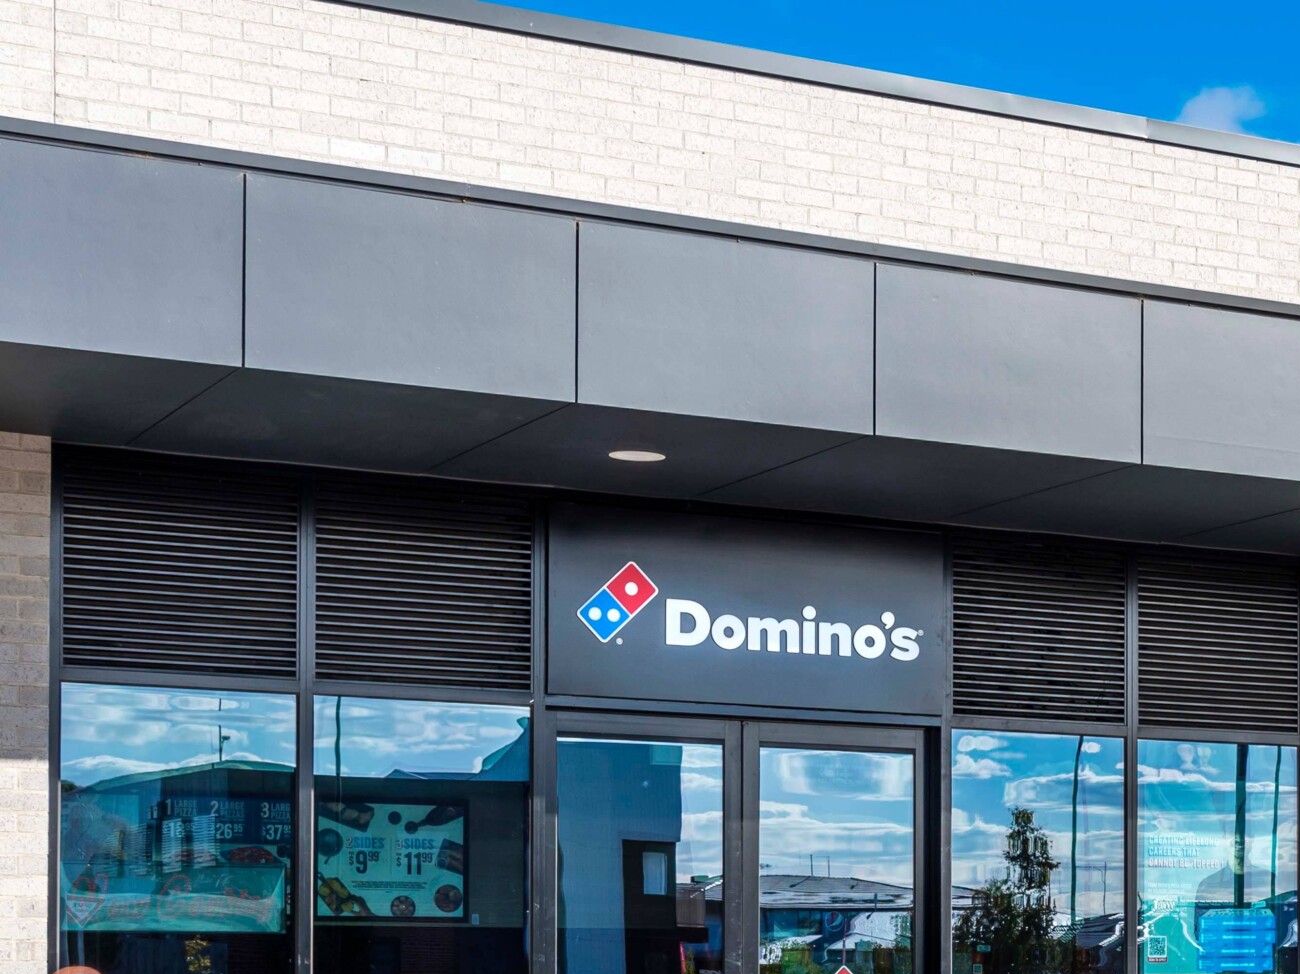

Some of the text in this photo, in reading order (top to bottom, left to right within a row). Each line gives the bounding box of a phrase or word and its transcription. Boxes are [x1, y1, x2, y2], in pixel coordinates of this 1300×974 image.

[665, 598, 920, 661] Domino's
[174, 800, 198, 809] LARGE
[210, 800, 245, 816] 2 LARGE
[261, 802, 291, 818] 3 LARG
[174, 808, 198, 817] PIZZA
[1148, 847, 1200, 858] CAREERS THAT
[1148, 858, 1177, 868] CANNOT
